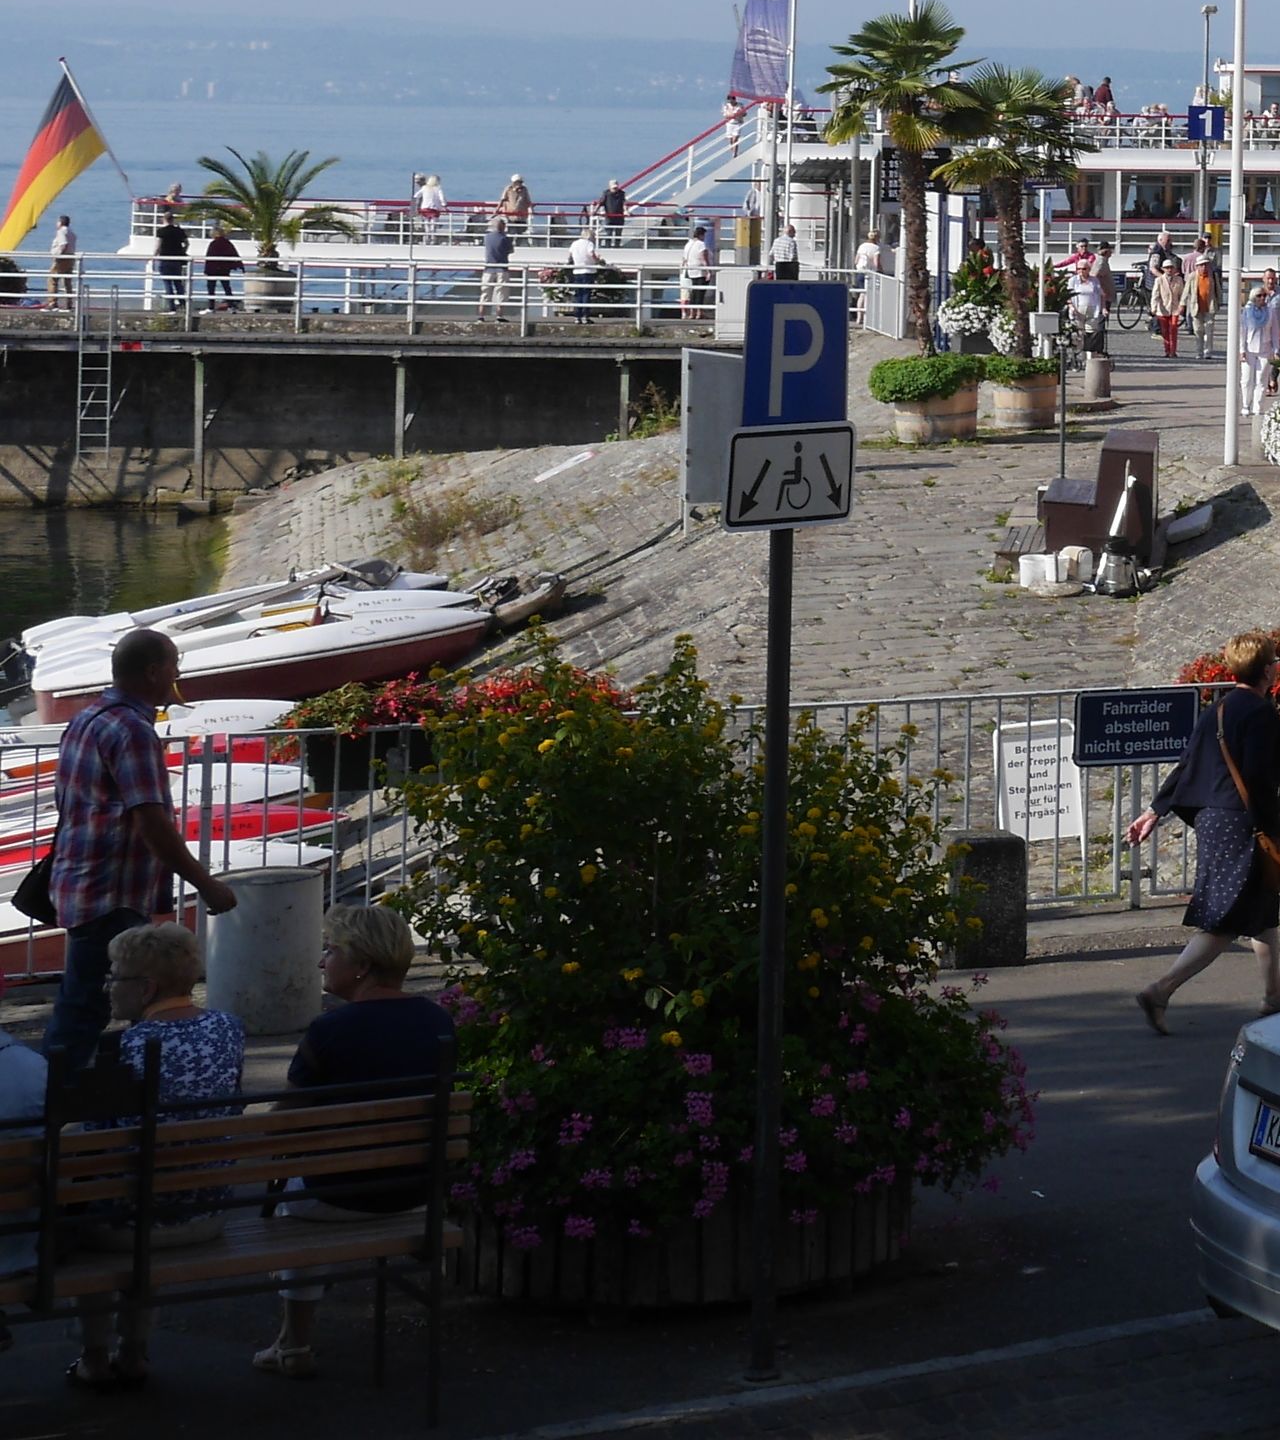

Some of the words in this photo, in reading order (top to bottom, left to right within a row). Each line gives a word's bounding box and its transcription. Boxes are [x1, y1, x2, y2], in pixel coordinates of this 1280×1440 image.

[1199, 110, 1213, 137] 1
[768, 303, 825, 417] P
[1102, 700, 1172, 715] Fahrräder
[1105, 720, 1170, 734] abstellen
[1084, 740, 1120, 753] nicht
[1124, 736, 1188, 755] gestattet
[1007, 760, 1024, 768] der
[1027, 755, 1069, 767] Treppn
